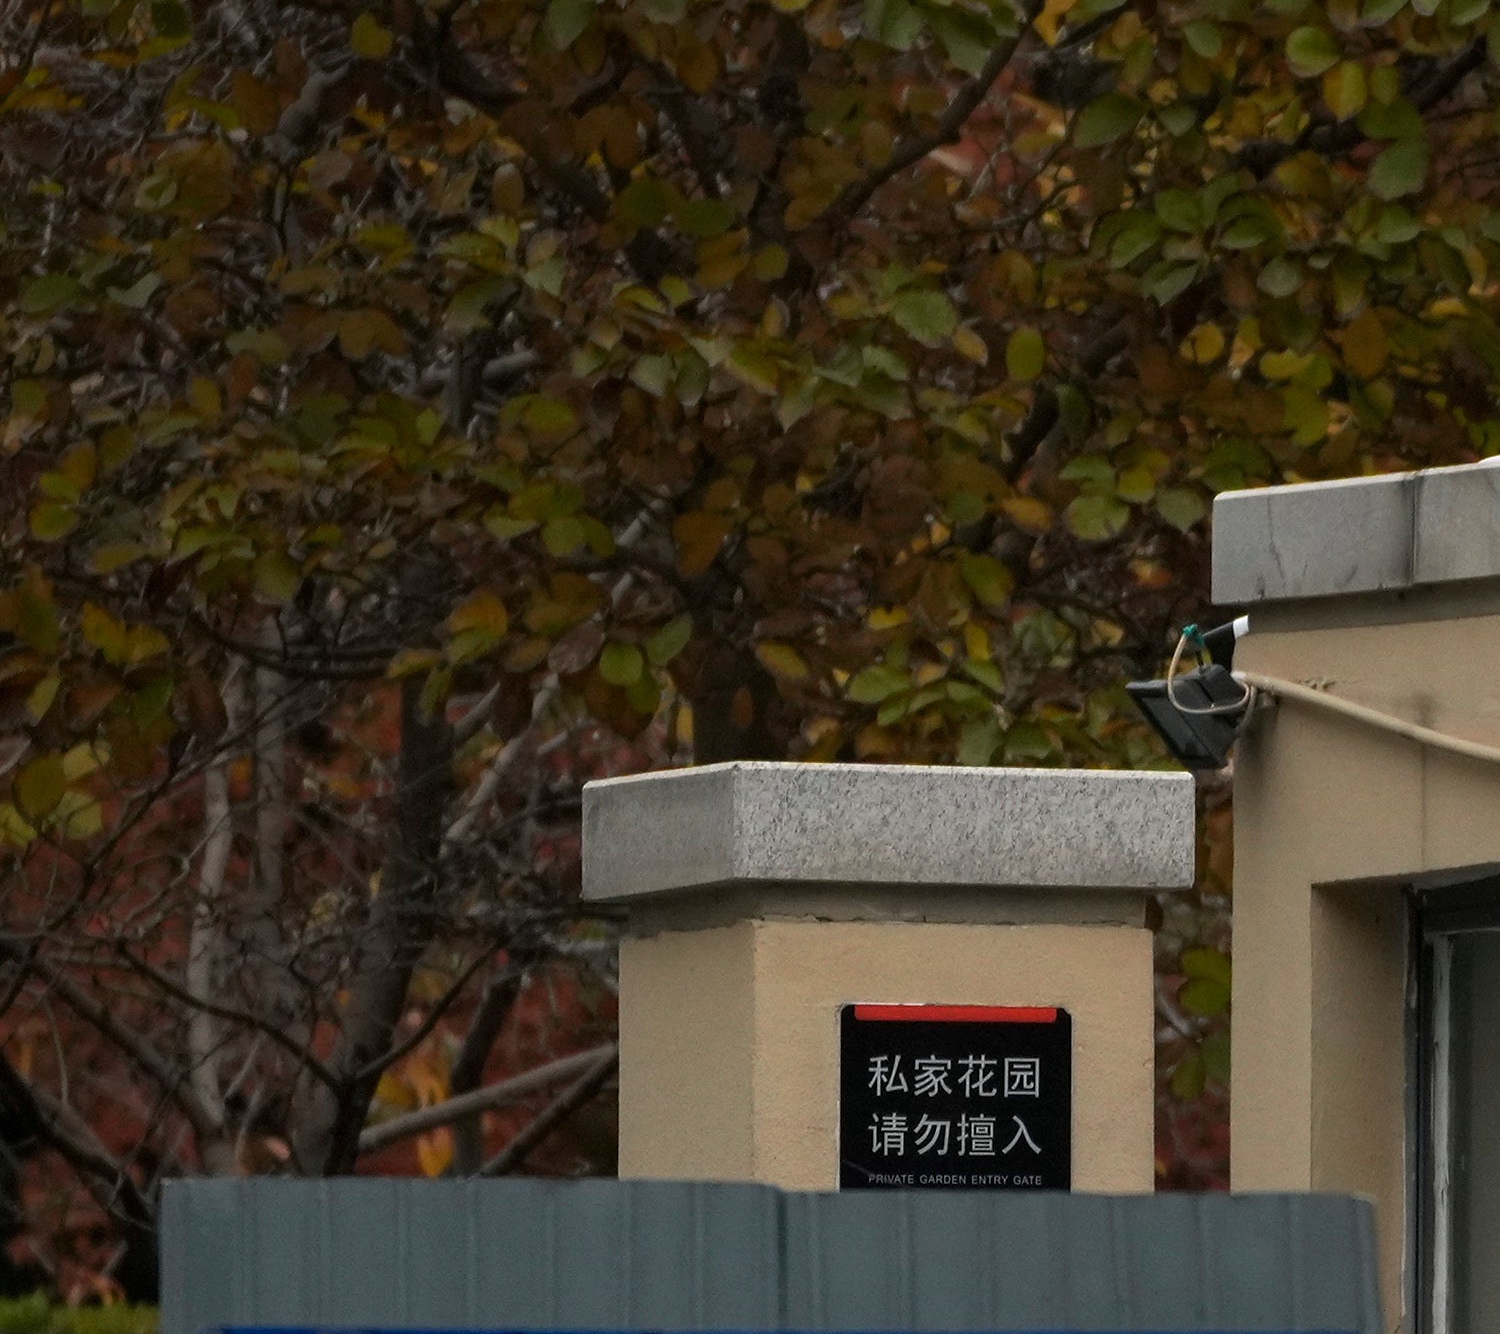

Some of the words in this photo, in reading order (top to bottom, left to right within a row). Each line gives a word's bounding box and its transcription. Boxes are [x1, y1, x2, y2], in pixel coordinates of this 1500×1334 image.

[867, 1054, 1041, 1099] 私家花园
[867, 1112, 1042, 1157] 请勿擅入
[868, 1173, 915, 1185] PRIVATE
[919, 1173, 967, 1185] GARDEN
[971, 1174, 1009, 1186] ENTRY
[1013, 1174, 1042, 1186] GATE
